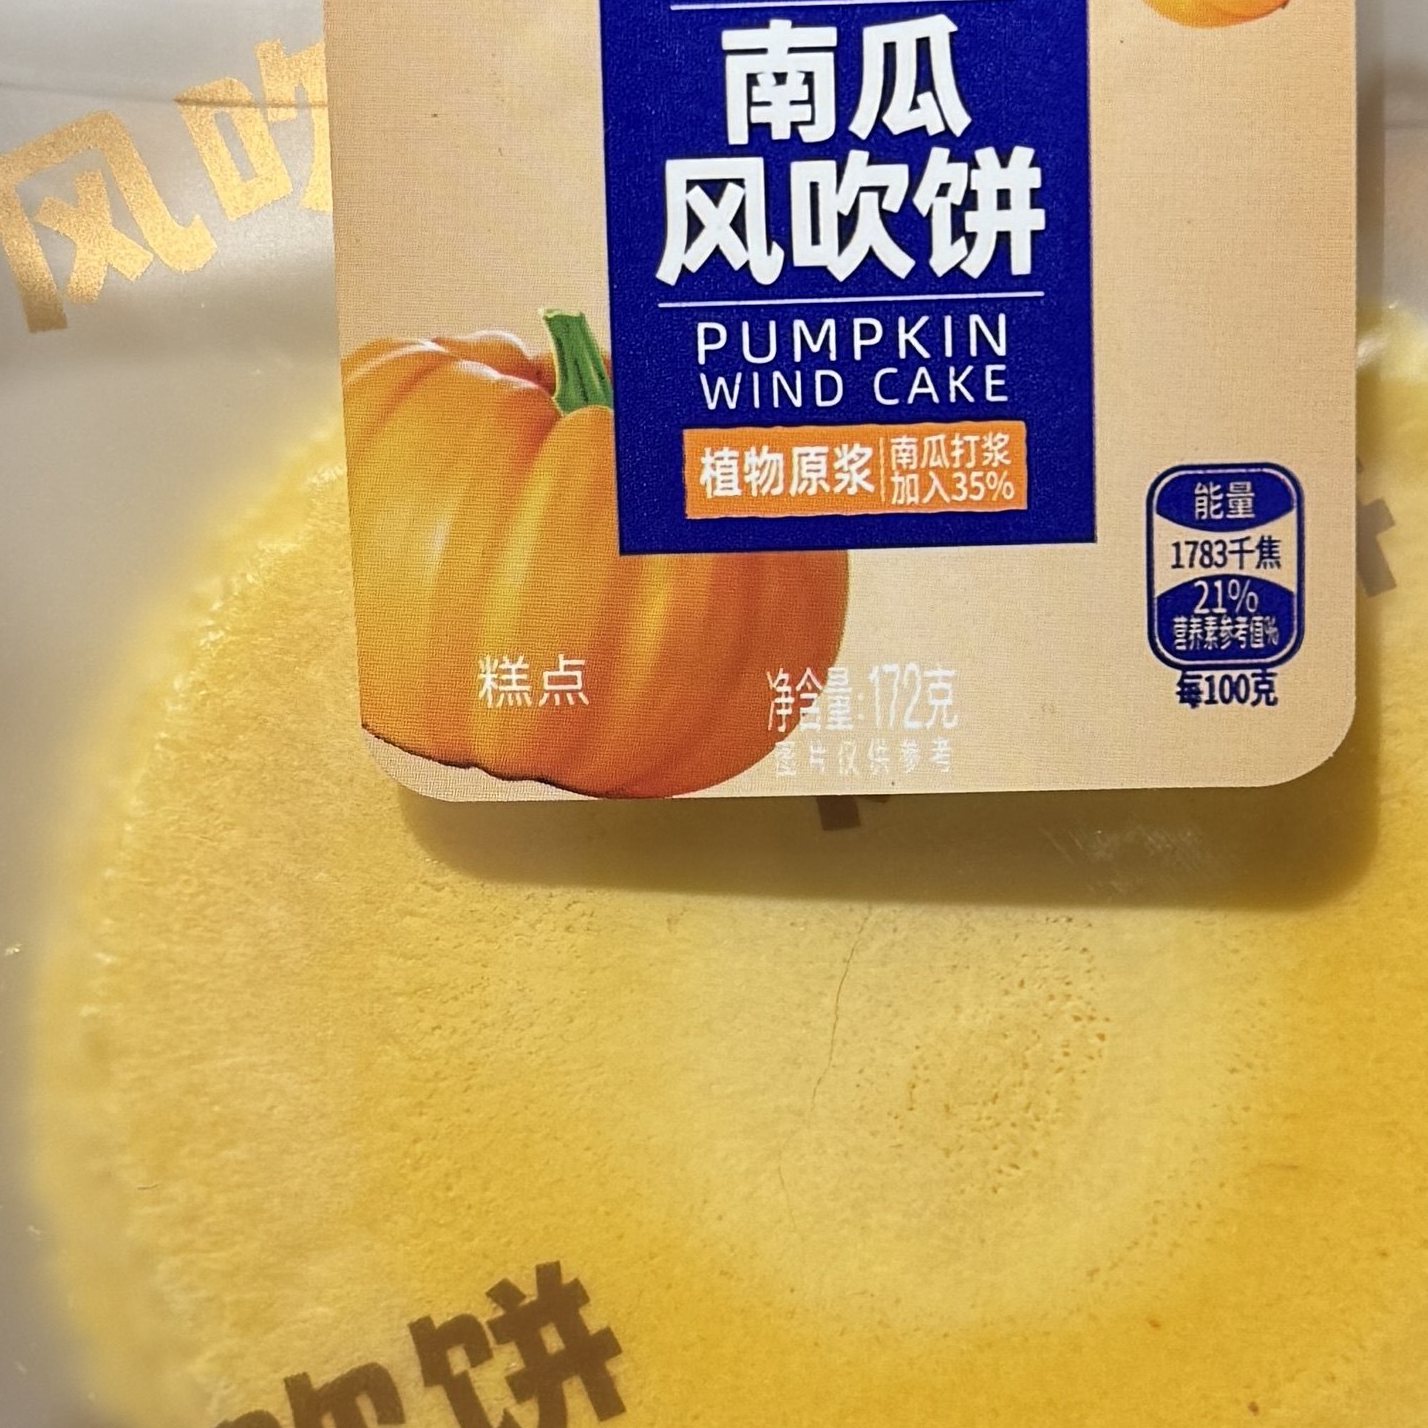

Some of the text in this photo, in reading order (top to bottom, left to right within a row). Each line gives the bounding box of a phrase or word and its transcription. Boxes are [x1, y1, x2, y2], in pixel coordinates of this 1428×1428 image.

[721, 14, 972, 145] 南瓜
[655, 145, 1046, 286] 风吹饼
[697, 313, 1007, 365] PUMPKIN
[699, 364, 1008, 410] WIND CAKE
[699, 442, 876, 499] 植物原浆
[890, 432, 1012, 471] 南瓜打浆
[890, 470, 1015, 506] 加入35%
[1193, 480, 1256, 521] 能量
[1170, 535, 1283, 570] 1783千焦
[1193, 578, 1259, 614] 21%
[1172, 615, 1279, 651] 营养素参考值%
[477, 653, 590, 709] 糕点
[1175, 668, 1279, 709] 每100克
